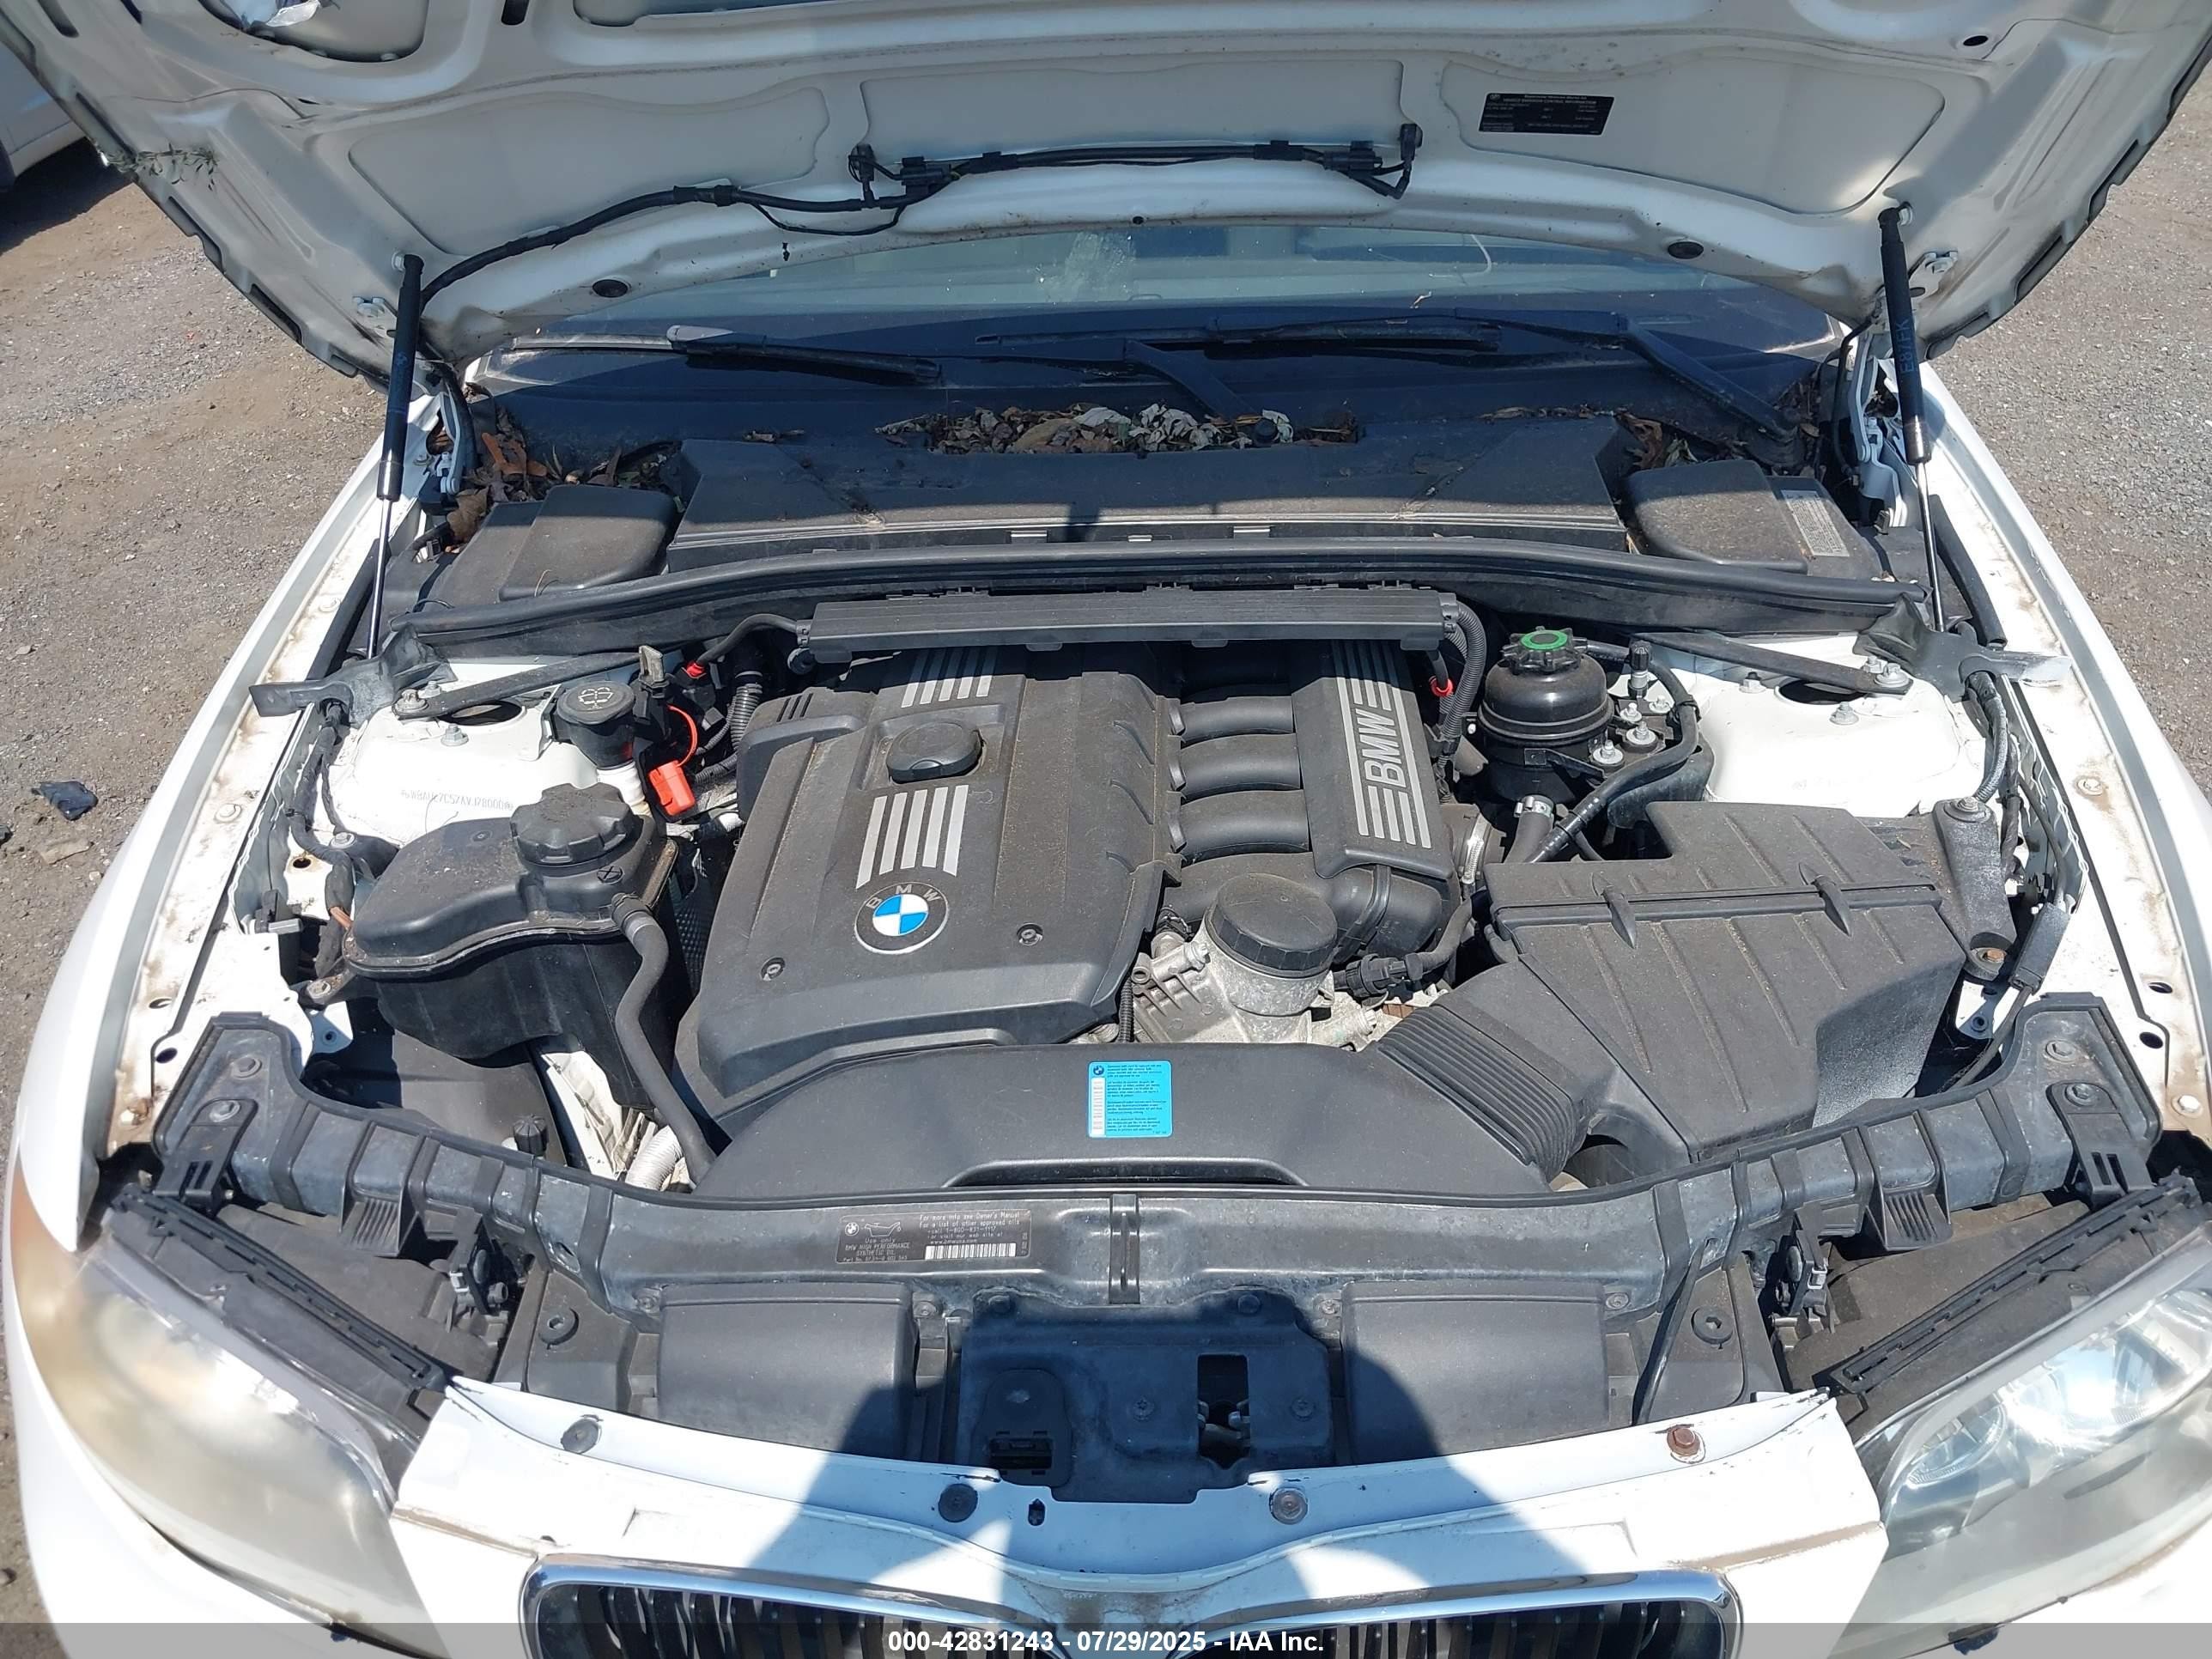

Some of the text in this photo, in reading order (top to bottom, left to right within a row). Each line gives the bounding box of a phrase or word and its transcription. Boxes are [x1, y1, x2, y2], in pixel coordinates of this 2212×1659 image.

[1356, 708, 1407, 787] BMW
[866, 884, 942, 909] BMW
[975, 1211, 998, 1219] Owner's
